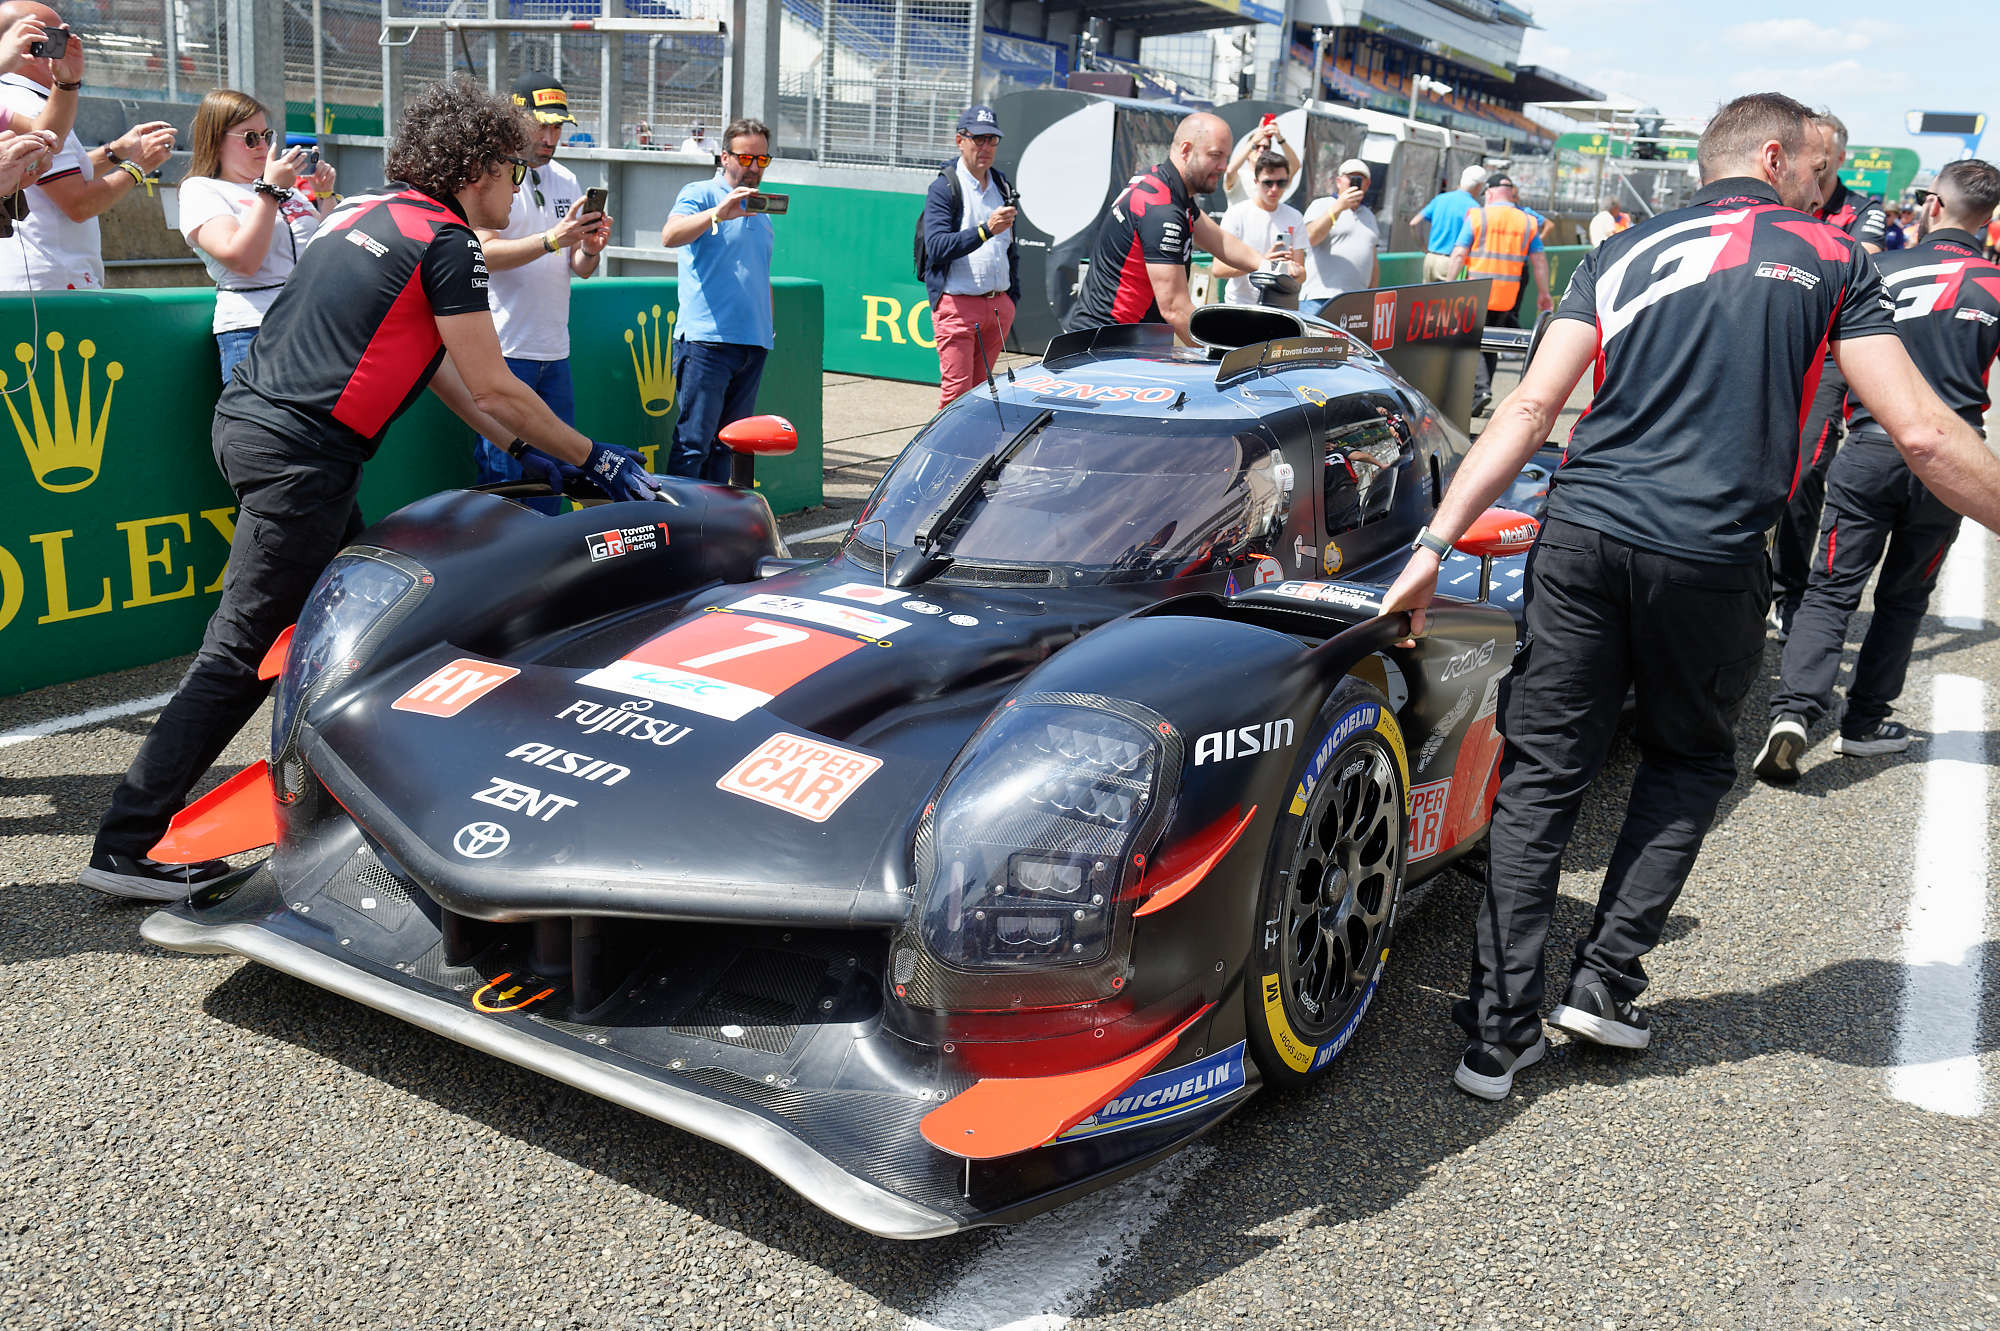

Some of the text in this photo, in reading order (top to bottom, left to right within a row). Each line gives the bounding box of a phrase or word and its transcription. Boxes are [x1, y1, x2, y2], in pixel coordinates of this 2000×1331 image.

[1934, 244, 1973, 256] DENSO
[1757, 267, 1785, 279] GR
[1374, 302, 1395, 340] HY
[1406, 296, 1478, 342] DENSO
[1303, 346, 1323, 354] GAZOO
[1324, 345, 1343, 354] Racing
[1010, 376, 1175, 402] DENSO
[592, 540, 624, 558] GR
[621, 525, 655, 536] TOYOTA
[624, 532, 655, 544] GAZOO
[626, 541, 657, 552] Racing
[1499, 525, 1528, 544] Mobil
[677, 621, 810, 669] 7
[1440, 638, 1495, 682] RAYS
[408, 667, 504, 705] HY
[554, 699, 695, 746] FUJITSU
[1316, 707, 1375, 775] MICHELIN
[766, 739, 866, 779] HYPER
[1194, 718, 1295, 767] AISIN
[505, 742, 631, 786] AISIN
[471, 776, 579, 822] ZENT
[738, 757, 844, 811] CAR
[1410, 786, 1446, 818] YPER
[1408, 812, 1440, 854] AR
[1279, 1031, 1310, 1065] PILOT SPORT
[1102, 1062, 1231, 1117] MICHELIN
